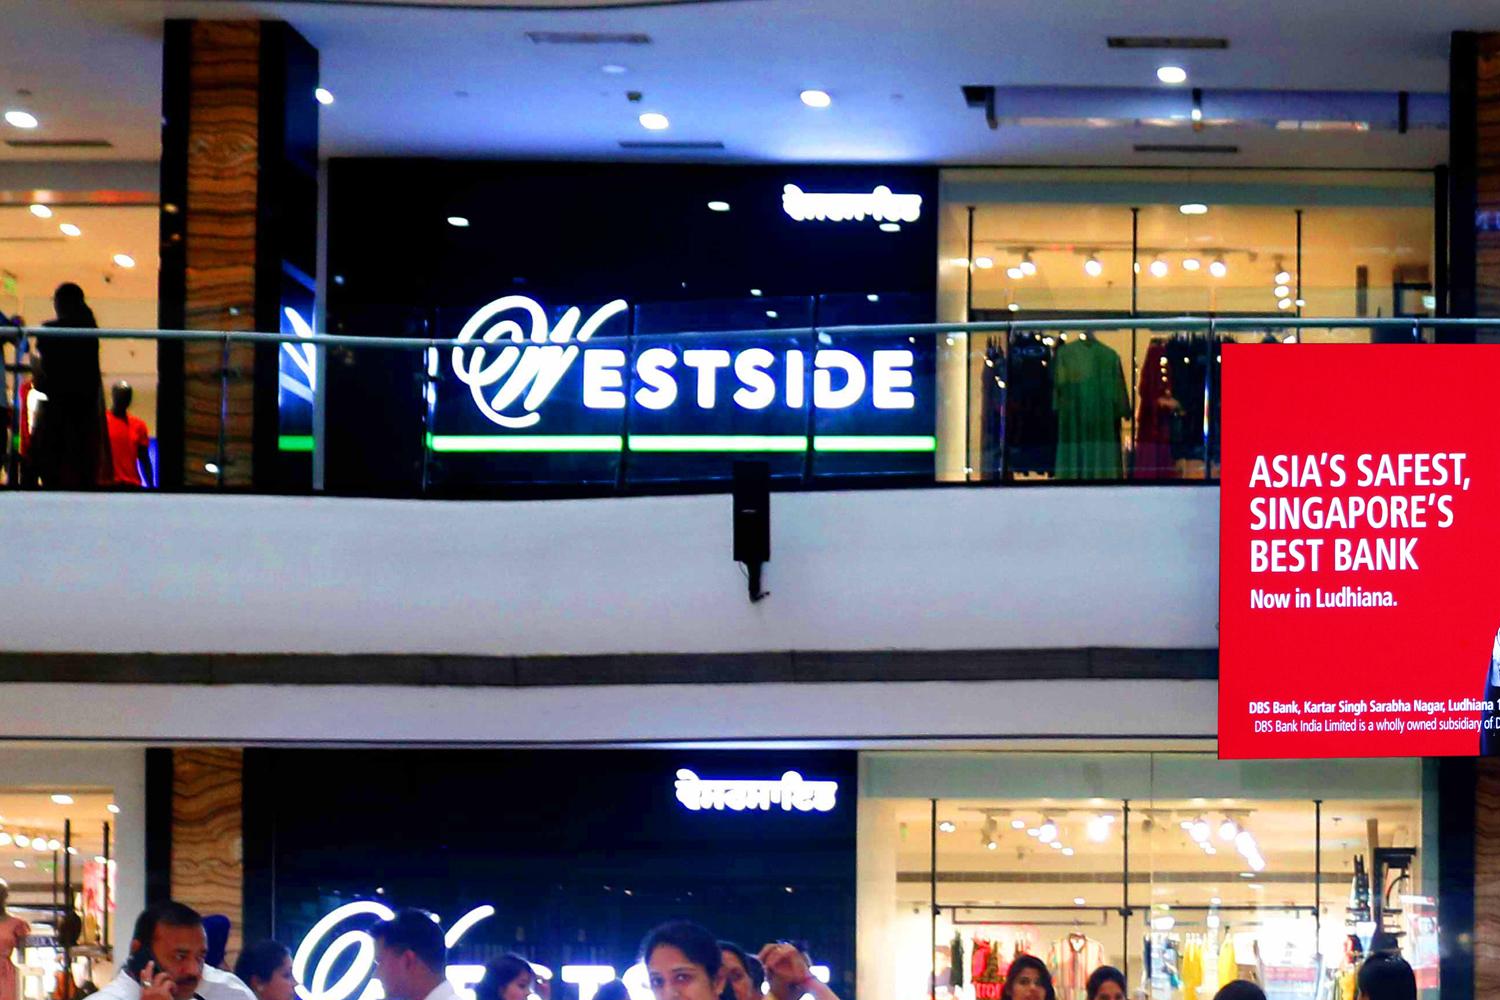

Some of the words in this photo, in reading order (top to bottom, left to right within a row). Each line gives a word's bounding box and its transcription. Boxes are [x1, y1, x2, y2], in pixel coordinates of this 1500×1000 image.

[451, 295, 915, 428] WESTSIDE
[1249, 452, 1347, 489] ASIA'S
[1357, 452, 1471, 492] SAFEST,
[1249, 494, 1454, 531] SINGAPORE'S
[1250, 539, 1324, 573] BEST
[1334, 538, 1419, 572] BANK
[1250, 589, 1291, 609] Now
[1295, 588, 1311, 609] in
[1316, 586, 1398, 608] Ludhiana.
[1249, 701, 1271, 715] DBS
[1273, 701, 1301, 716] Bank,
[1304, 700, 1336, 714] Kartar
[1339, 699, 1367, 716] Singh
[1370, 699, 1411, 713] Sarabha
[1414, 699, 1446, 715] Nagar,
[1448, 698, 1494, 712] Ludhiana
[1254, 720, 1273, 733] DBS
[1275, 719, 1298, 732] Bank
[1300, 719, 1322, 732] India
[1324, 719, 1357, 732] Limited
[1359, 719, 1366, 731] is
[1368, 721, 1374, 731] a
[1376, 718, 1404, 734] wholly
[1406, 718, 1437, 731] owned
[1439, 717, 1482, 733] subsidiary
[1484, 717, 1494, 730] of
